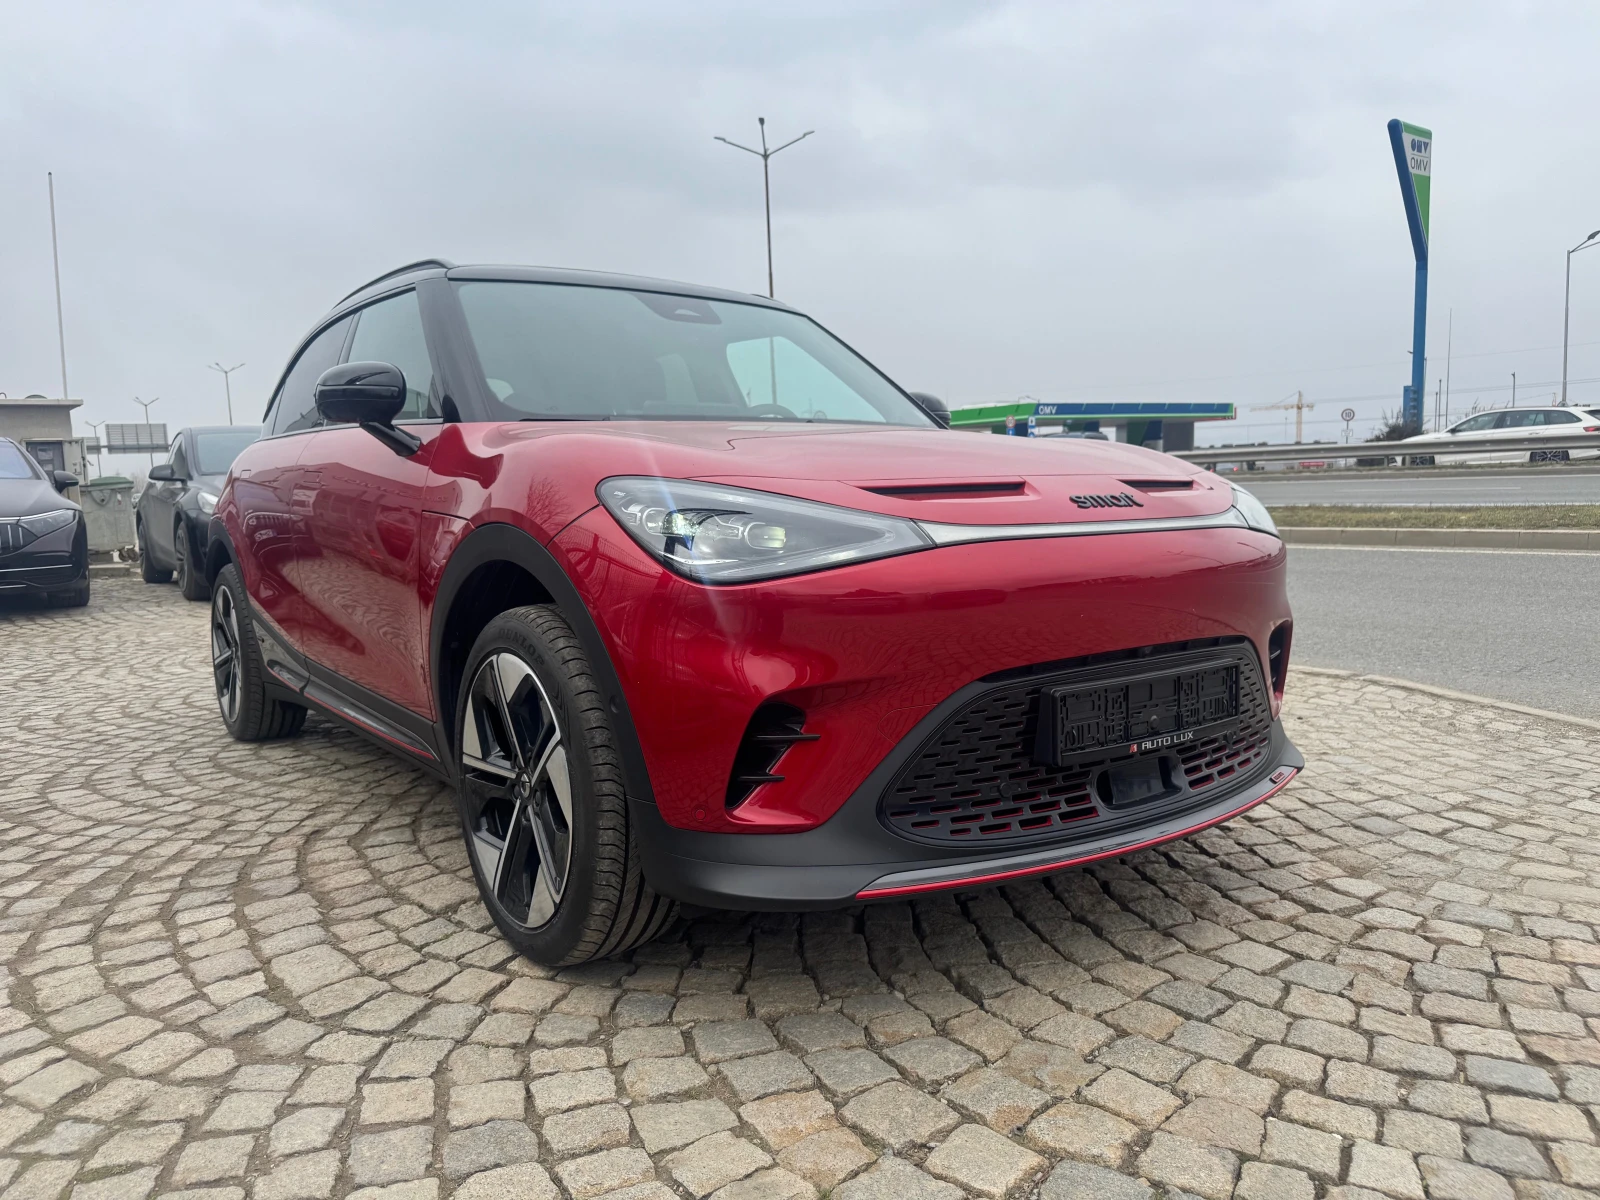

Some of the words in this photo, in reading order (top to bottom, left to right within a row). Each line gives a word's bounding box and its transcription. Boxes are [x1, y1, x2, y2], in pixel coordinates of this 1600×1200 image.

[1411, 138, 1429, 154] OMV
[1411, 157, 1428, 171] OMV
[1038, 405, 1057, 415] OMV
[1069, 492, 1144, 509] smart
[499, 629, 545, 665] DUNLOP
[1142, 737, 1170, 750] AUTO
[1174, 731, 1193, 743] LUX
